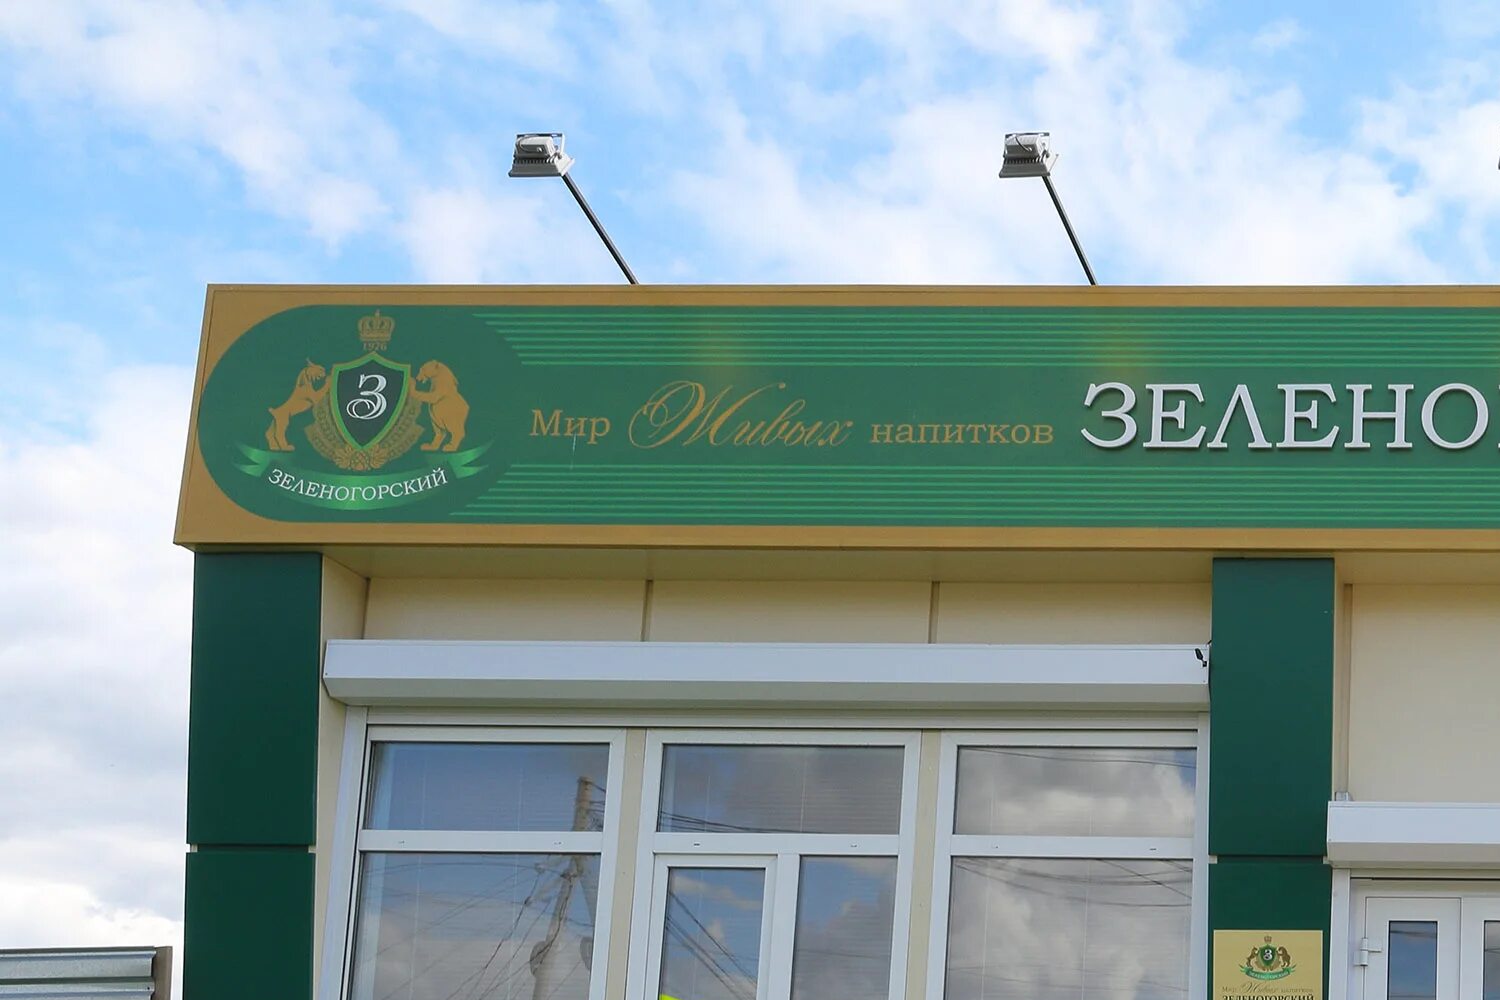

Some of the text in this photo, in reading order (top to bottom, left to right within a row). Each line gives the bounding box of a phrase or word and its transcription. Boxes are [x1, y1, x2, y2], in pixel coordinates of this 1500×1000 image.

[530, 380, 1055, 448] Мир Живых напитков
[268, 467, 448, 502] ЗЕЛЕНОГОРСКИЙ
